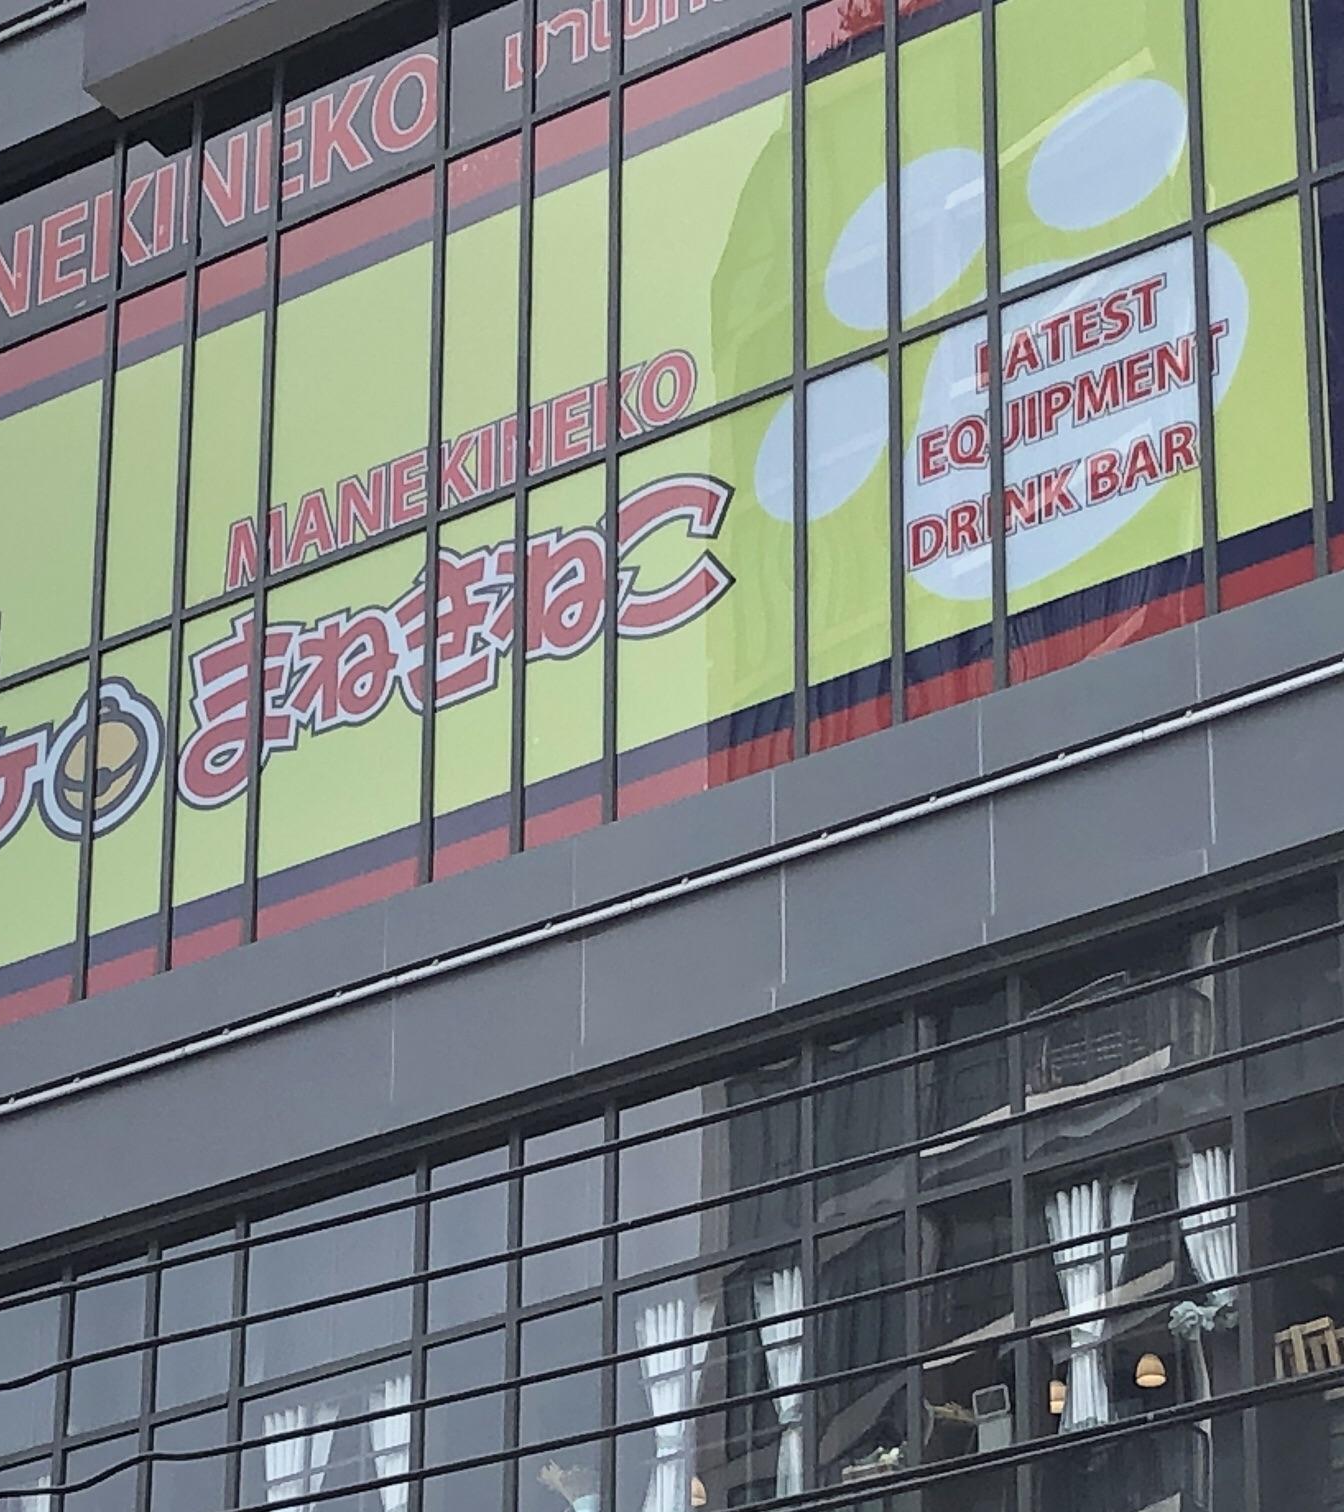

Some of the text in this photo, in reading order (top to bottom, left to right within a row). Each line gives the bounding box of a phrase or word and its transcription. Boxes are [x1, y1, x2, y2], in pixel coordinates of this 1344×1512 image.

[917, 318, 1229, 486] EQUIPMENT
[975, 272, 1167, 393] LATEST
[223, 349, 698, 595] MANEKINEKO
[907, 420, 1200, 570] DRINK BAR
[180, 476, 733, 808] まねきねこ
